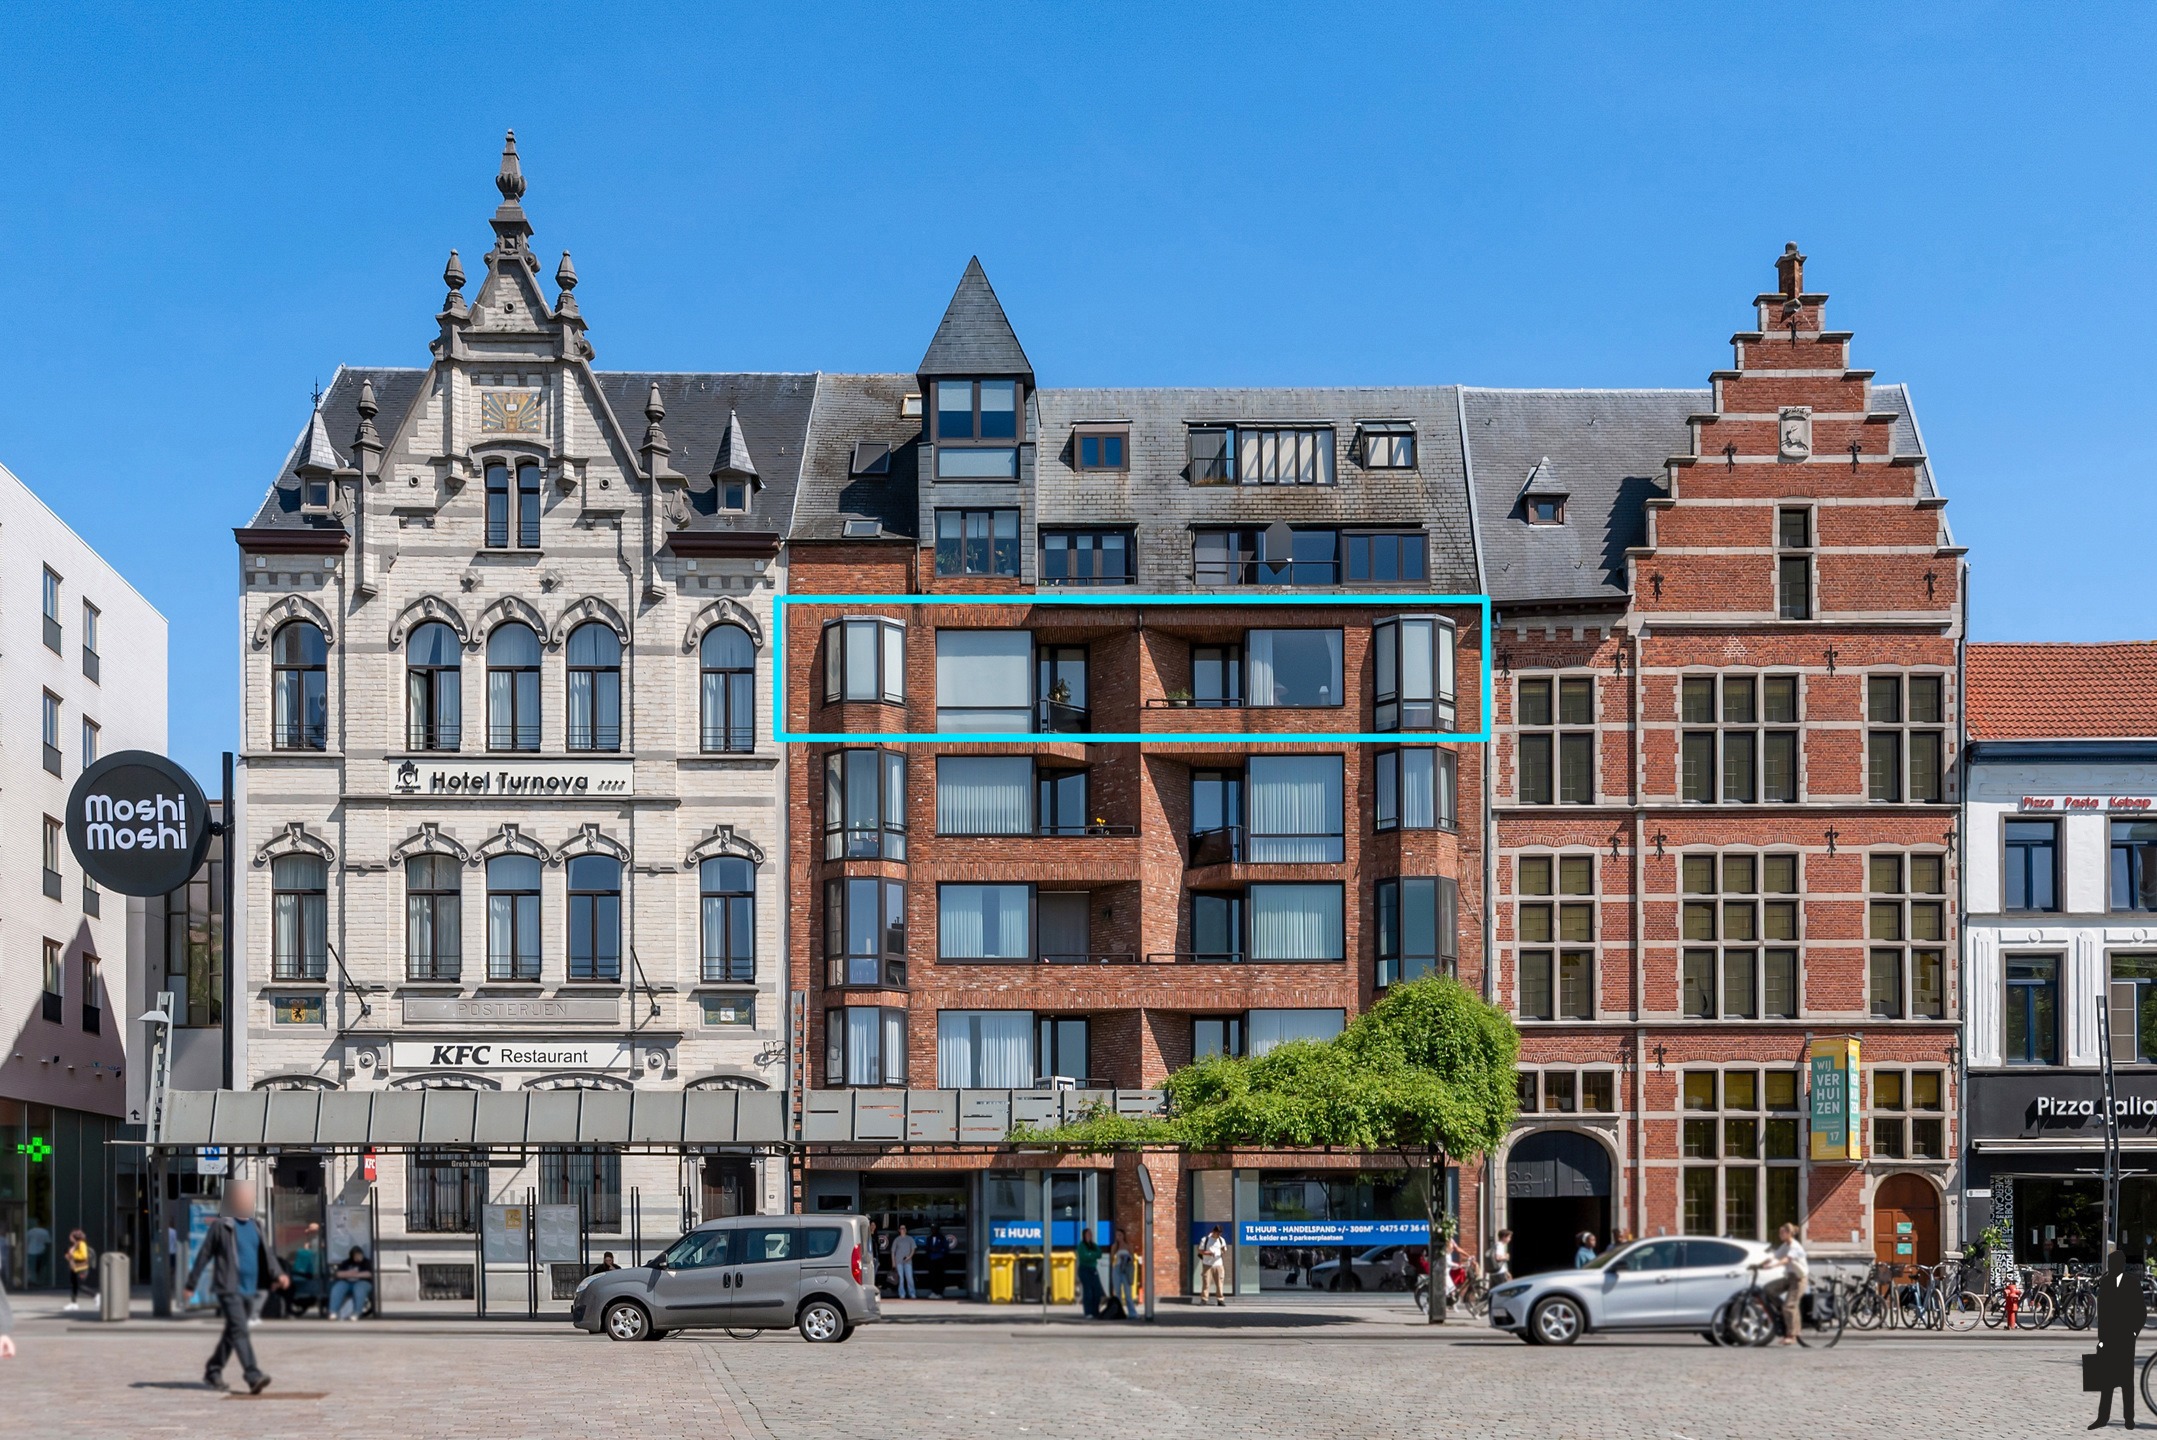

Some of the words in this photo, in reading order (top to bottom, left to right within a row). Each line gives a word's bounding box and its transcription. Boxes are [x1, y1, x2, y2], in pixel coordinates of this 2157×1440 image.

[433, 771, 490, 790] Hotel
[500, 771, 589, 790] Turnova
[2023, 796, 2054, 808] Pizza
[2064, 796, 2099, 808] Pasta
[430, 1045, 491, 1065] KFC
[501, 1049, 588, 1063] Restaurant
[1817, 1061, 1832, 1072] WIJ
[1817, 1074, 1840, 1086] VER
[1817, 1088, 1840, 1101] HUI
[1817, 1101, 1840, 1115] ZEN
[2037, 1096, 2094, 1116] Pizza
[1830, 1132, 1840, 1141] 17
[364, 1157, 375, 1169] KFC
[451, 1160, 469, 1168] Grote
[470, 1160, 490, 1168] Markt
[994, 1228, 1006, 1238] TE
[1008, 1228, 1042, 1238] HUUR
[1380, 1224, 1399, 1232] 0475
[1400, 1224, 1409, 1232] 47
[1410, 1224, 1420, 1232] 36
[1421, 1224, 1429, 1232] 41
